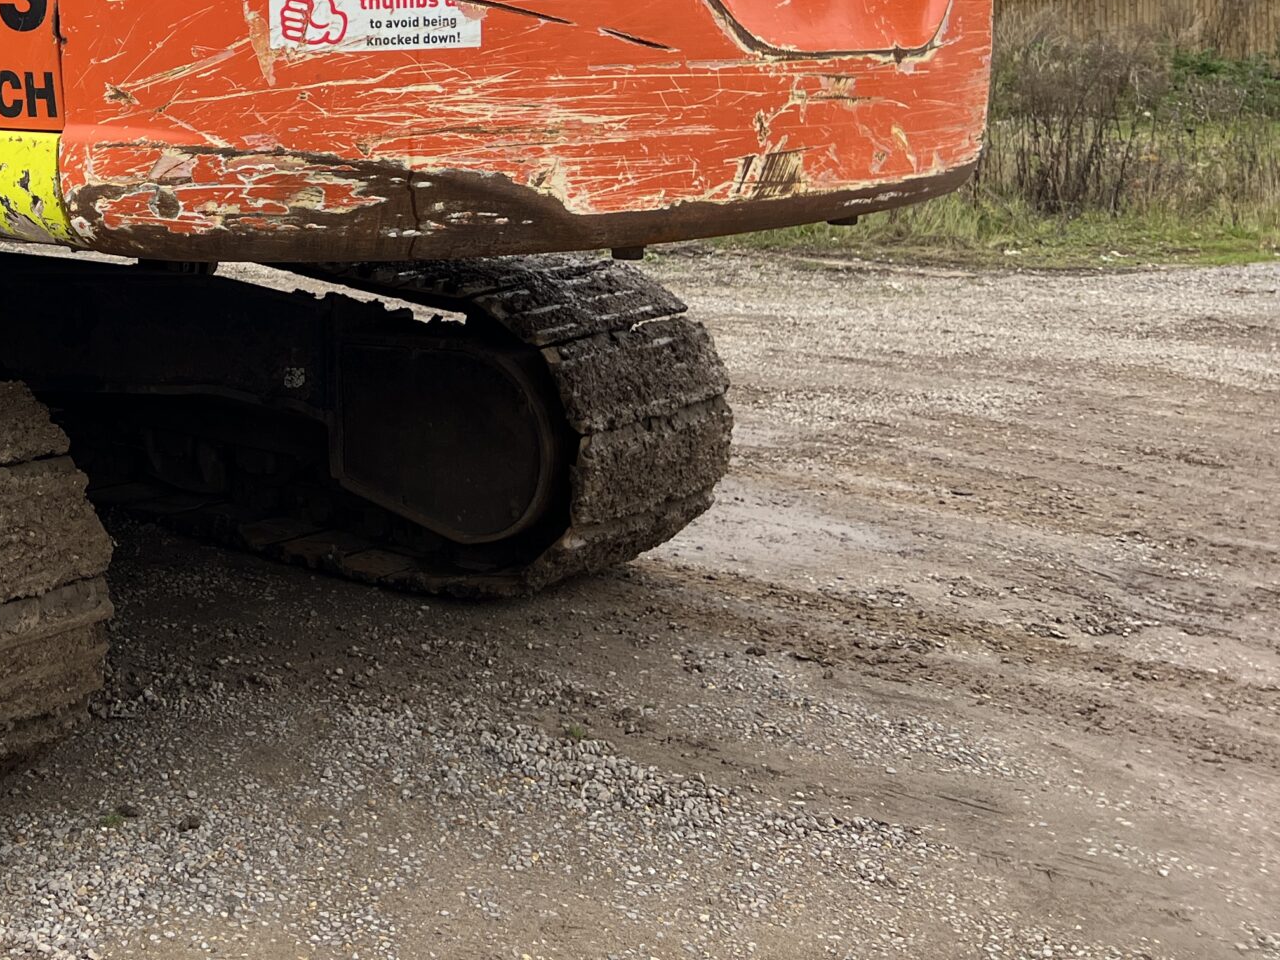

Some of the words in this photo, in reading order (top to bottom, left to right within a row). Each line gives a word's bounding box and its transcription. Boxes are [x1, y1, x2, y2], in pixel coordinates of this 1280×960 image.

[369, 18, 382, 29] to
[385, 16, 420, 29] avoid
[423, 15, 457, 29] being
[366, 33, 420, 46] knocked
[423, 31, 461, 44] down!
